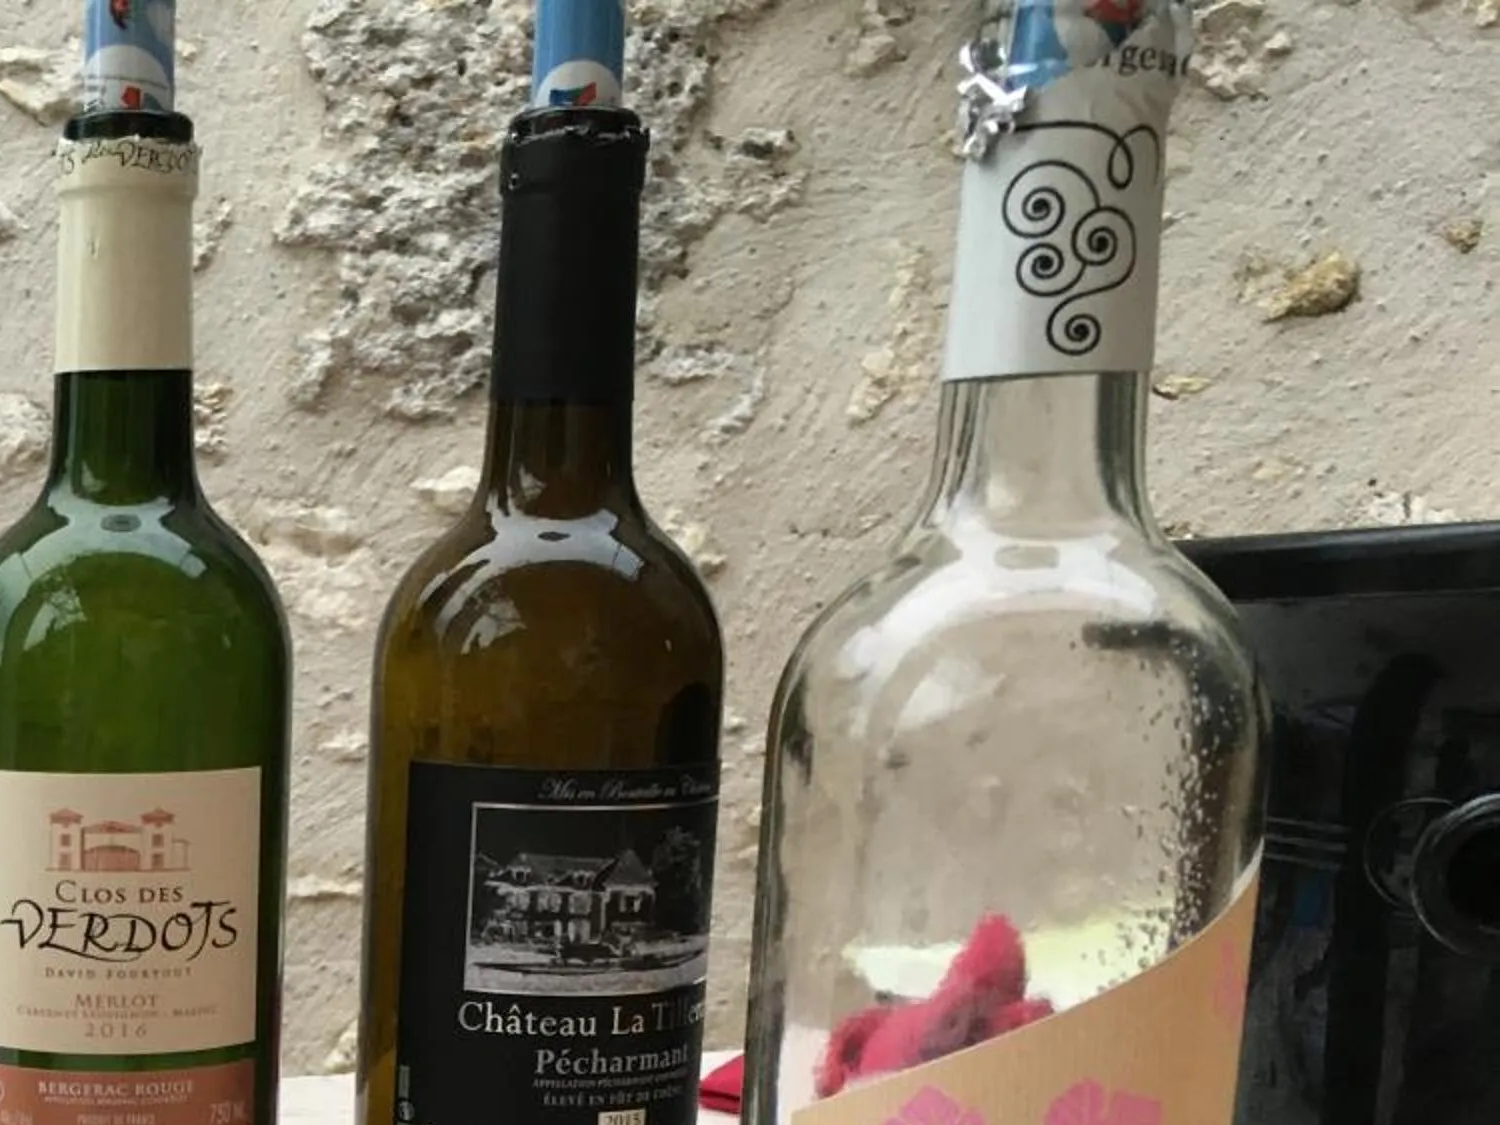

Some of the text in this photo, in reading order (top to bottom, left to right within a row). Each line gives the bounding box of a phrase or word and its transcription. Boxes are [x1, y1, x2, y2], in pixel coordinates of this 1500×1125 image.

[55, 879, 184, 904] CLOS DES
[0, 899, 238, 962] VERDOTS
[45, 967, 97, 979] DAVID
[75, 993, 159, 1009] MERLOT
[458, 1000, 597, 1036] Château
[611, 1005, 645, 1035] La
[84, 1022, 148, 1039] 2016
[533, 1043, 689, 1075] Pécharmant
[37, 1080, 194, 1097] BERGERAC ROUGE
